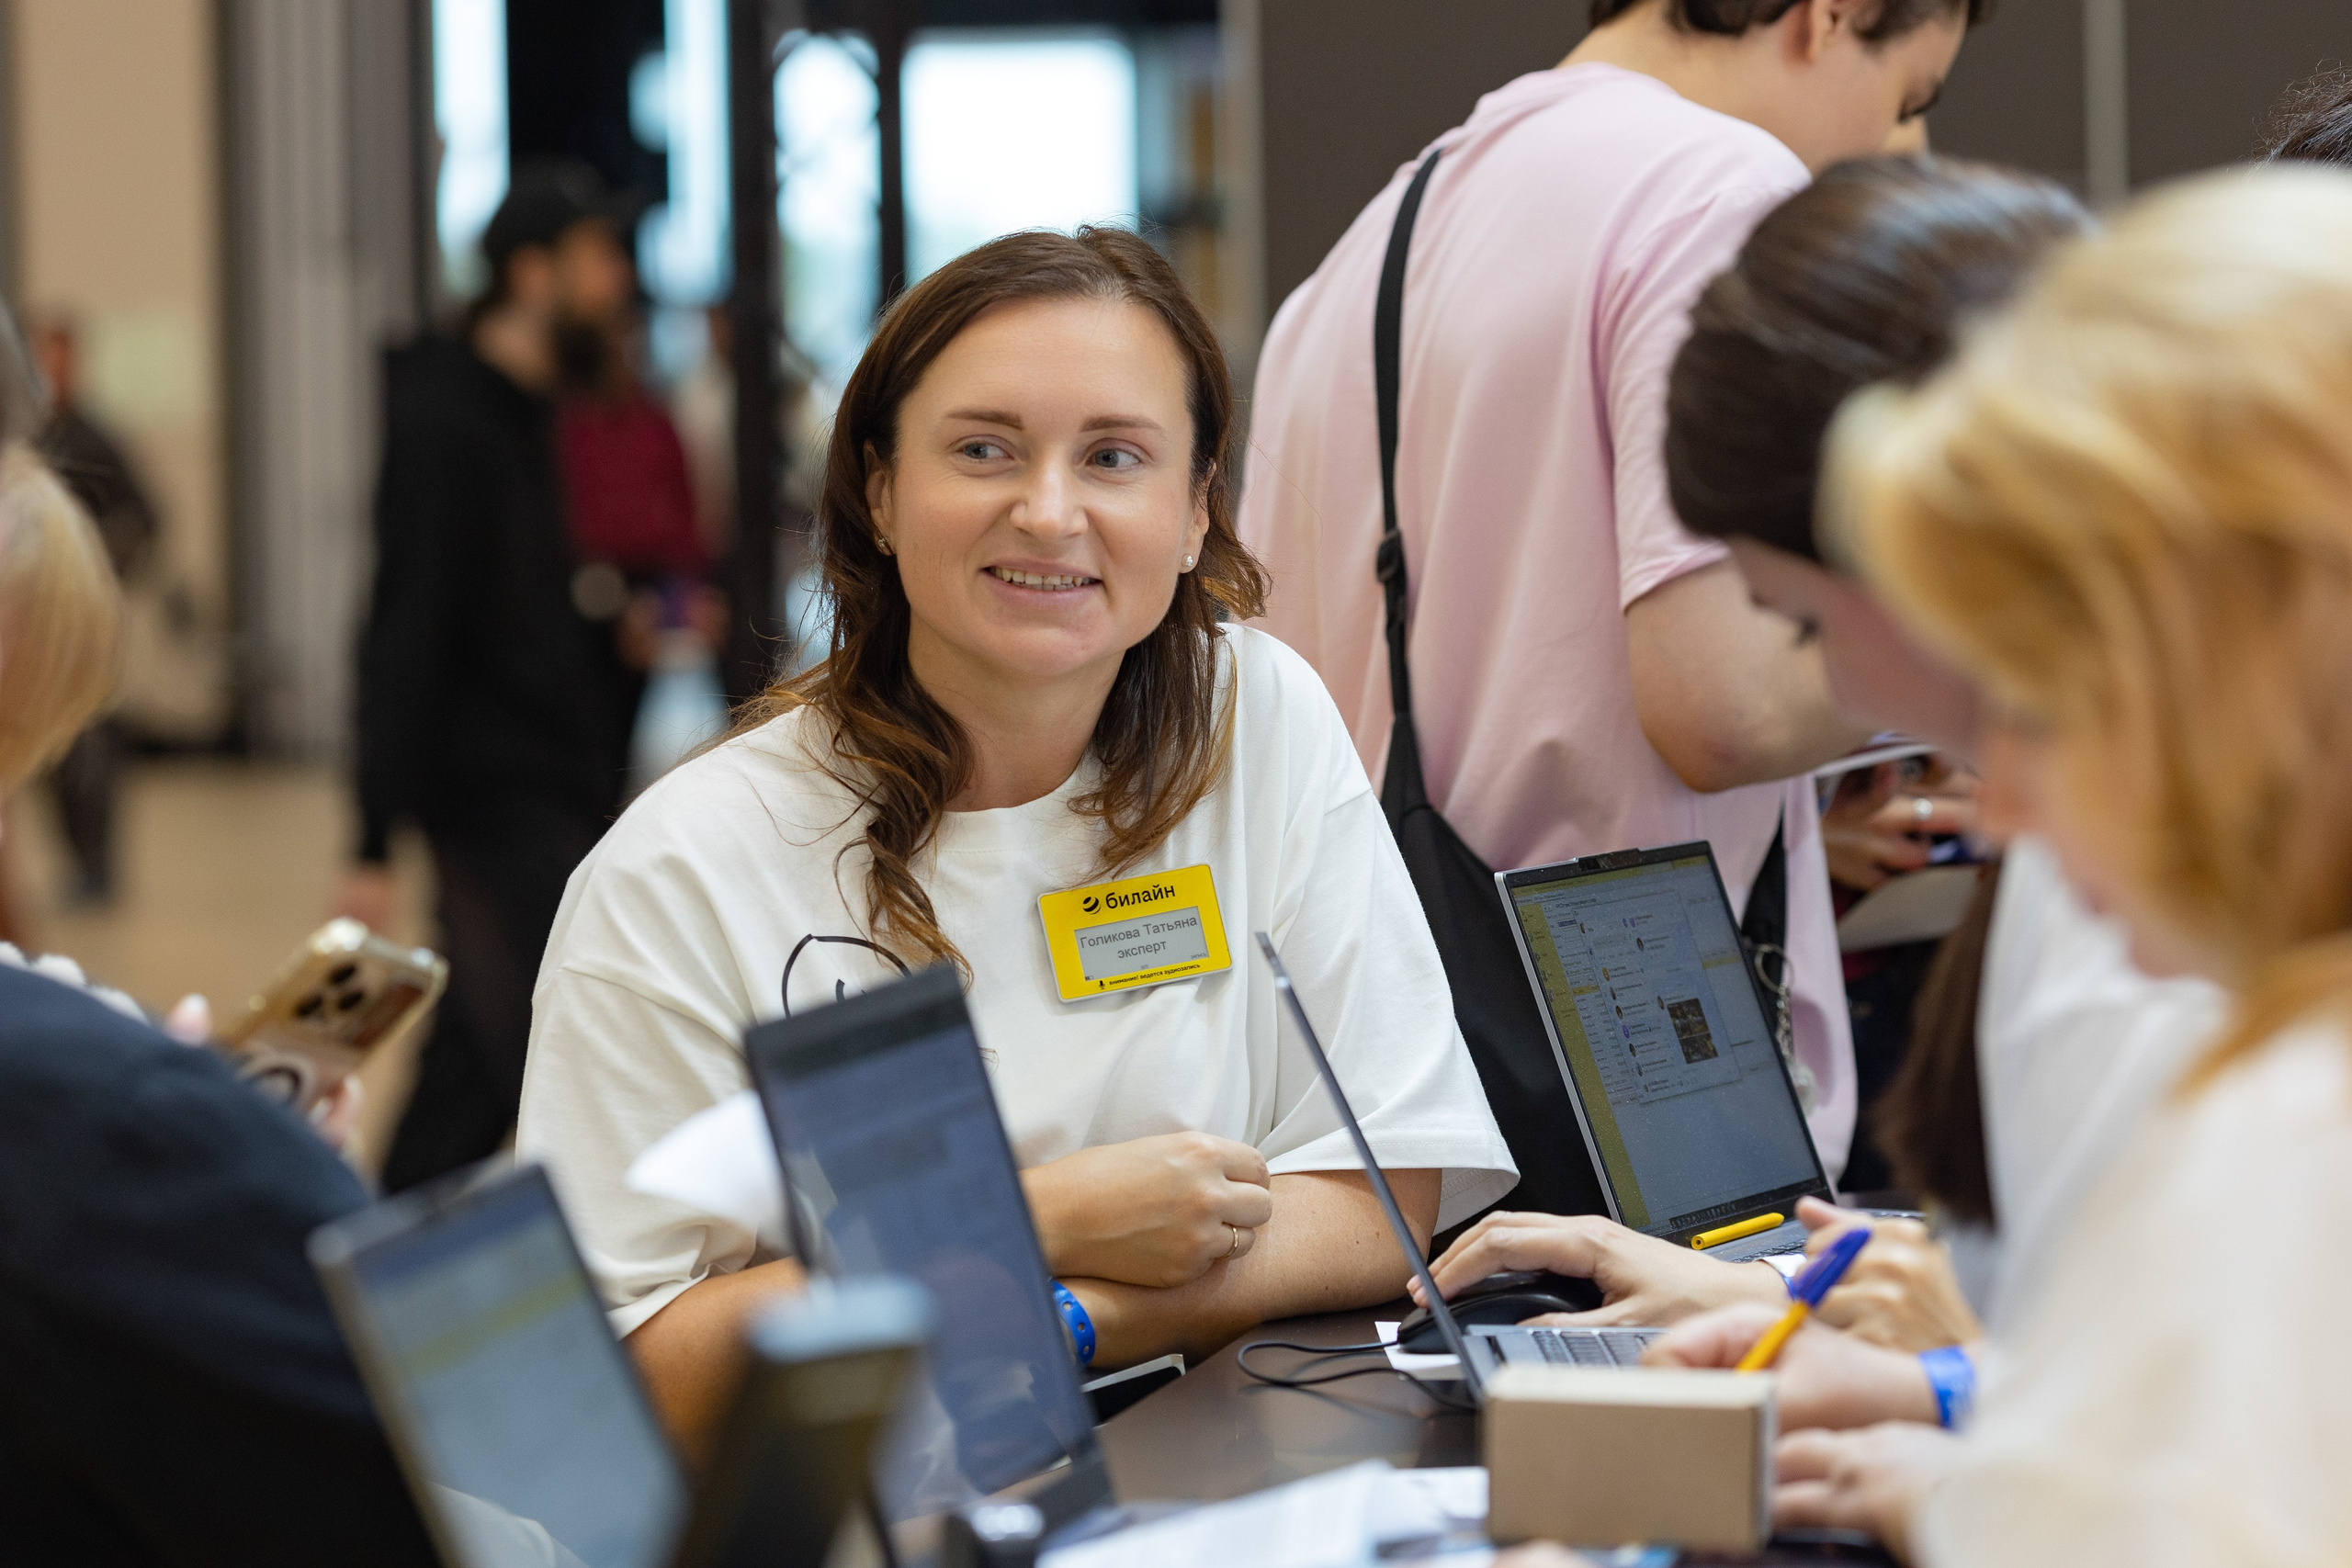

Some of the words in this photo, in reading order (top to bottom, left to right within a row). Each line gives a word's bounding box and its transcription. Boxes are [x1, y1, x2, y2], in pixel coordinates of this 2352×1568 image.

[1105, 885, 1176, 909] билайн
[1080, 928, 1140, 949] Голикова
[1143, 916, 1198, 936] Татьяна
[1117, 941, 1167, 959] эксперт
[1109, 975, 1139, 985] внимание!
[1164, 964, 1201, 975] аудиозапись
